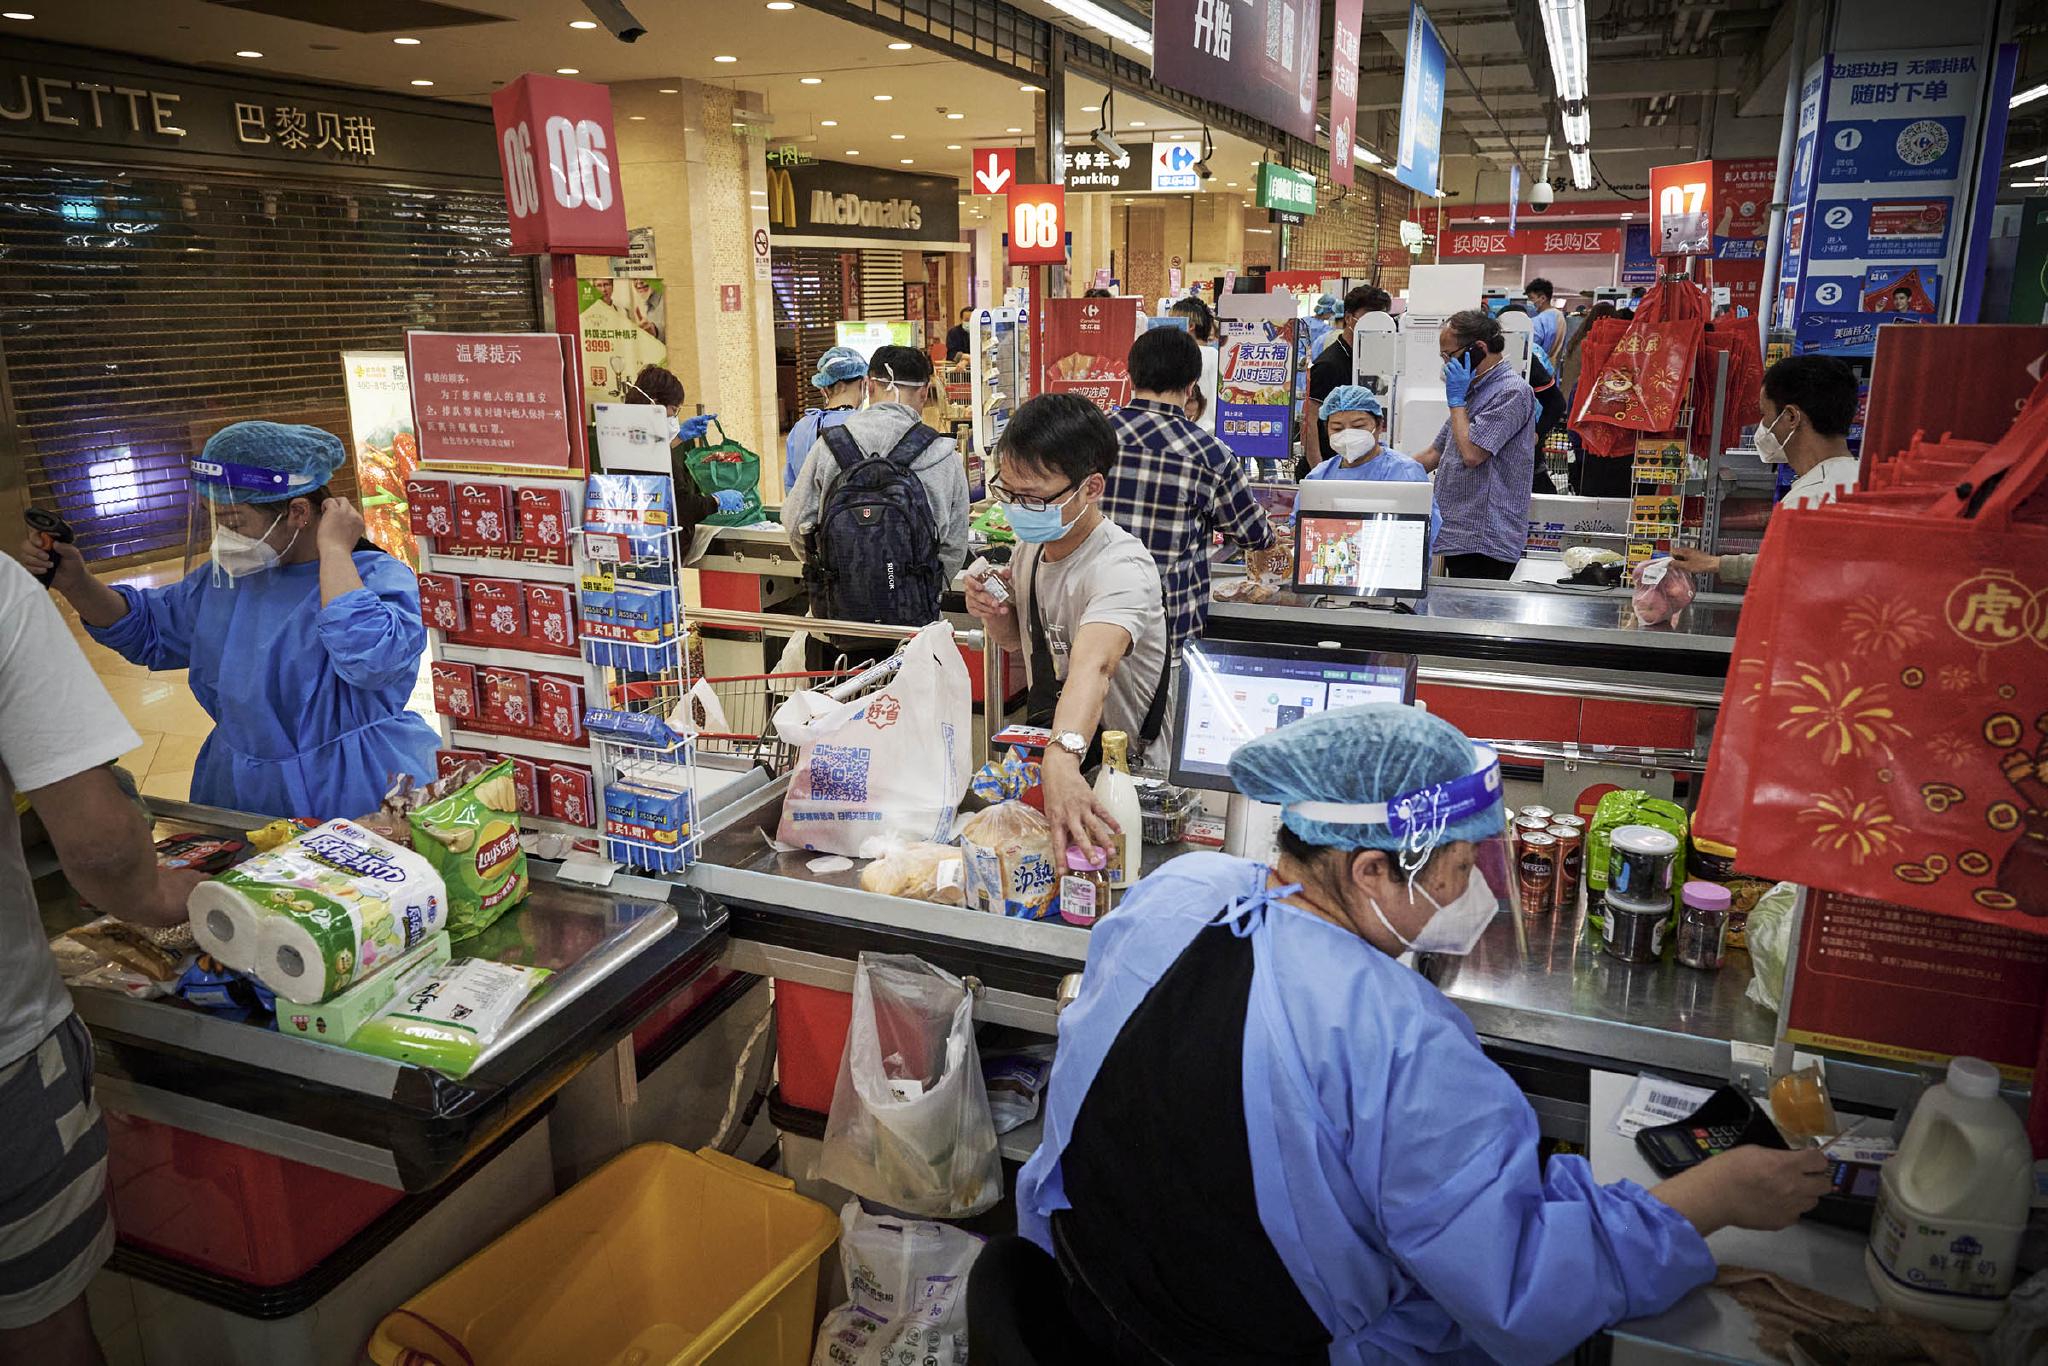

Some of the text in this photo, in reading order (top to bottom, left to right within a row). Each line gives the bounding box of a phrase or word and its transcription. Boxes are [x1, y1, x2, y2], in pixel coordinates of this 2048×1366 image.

[1906, 57, 1977, 75] 无需排队
[1850, 80, 1948, 105] 随时下单
[235, 102, 376, 156] 巴黎贝甜
[503, 120, 539, 218] 06
[545, 115, 613, 211] 06
[1071, 173, 1119, 186] parking
[1660, 183, 1706, 225] 07
[1014, 202, 1058, 249] 08
[1453, 235, 1507, 254] 换购区
[1545, 232, 1602, 252] 换购区
[584, 329, 638, 340] 韩国进口种植牙
[456, 343, 522, 365] 温馨提示
[585, 340, 611, 352] 3999
[1240, 344, 1288, 361] 家乐福
[1235, 368, 1285, 381] 小时到家
[478, 843, 501, 869] Lay's
